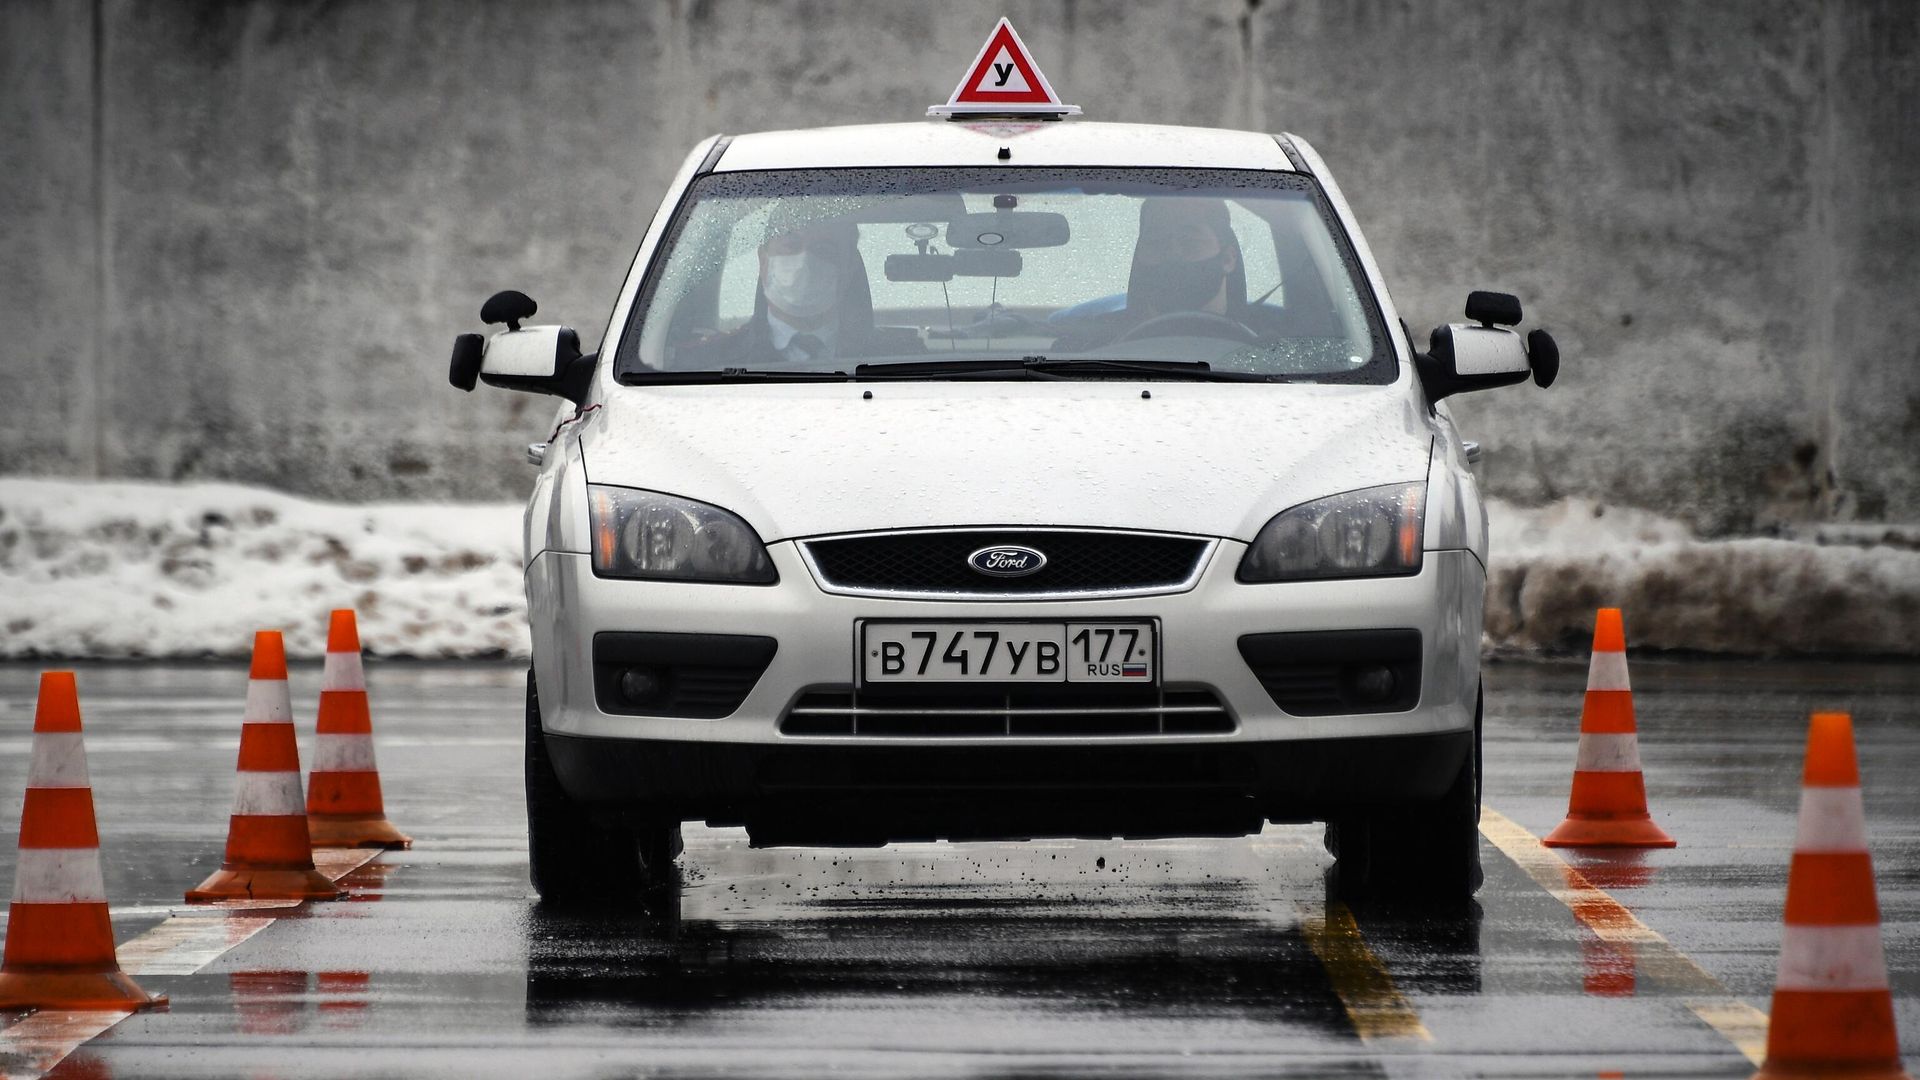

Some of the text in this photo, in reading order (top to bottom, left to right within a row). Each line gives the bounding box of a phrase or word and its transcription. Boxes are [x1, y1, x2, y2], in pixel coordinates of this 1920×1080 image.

[986, 551, 1028, 569] Ford
[1072, 628, 1140, 663] 177
[1087, 663, 1121, 677] RUS
